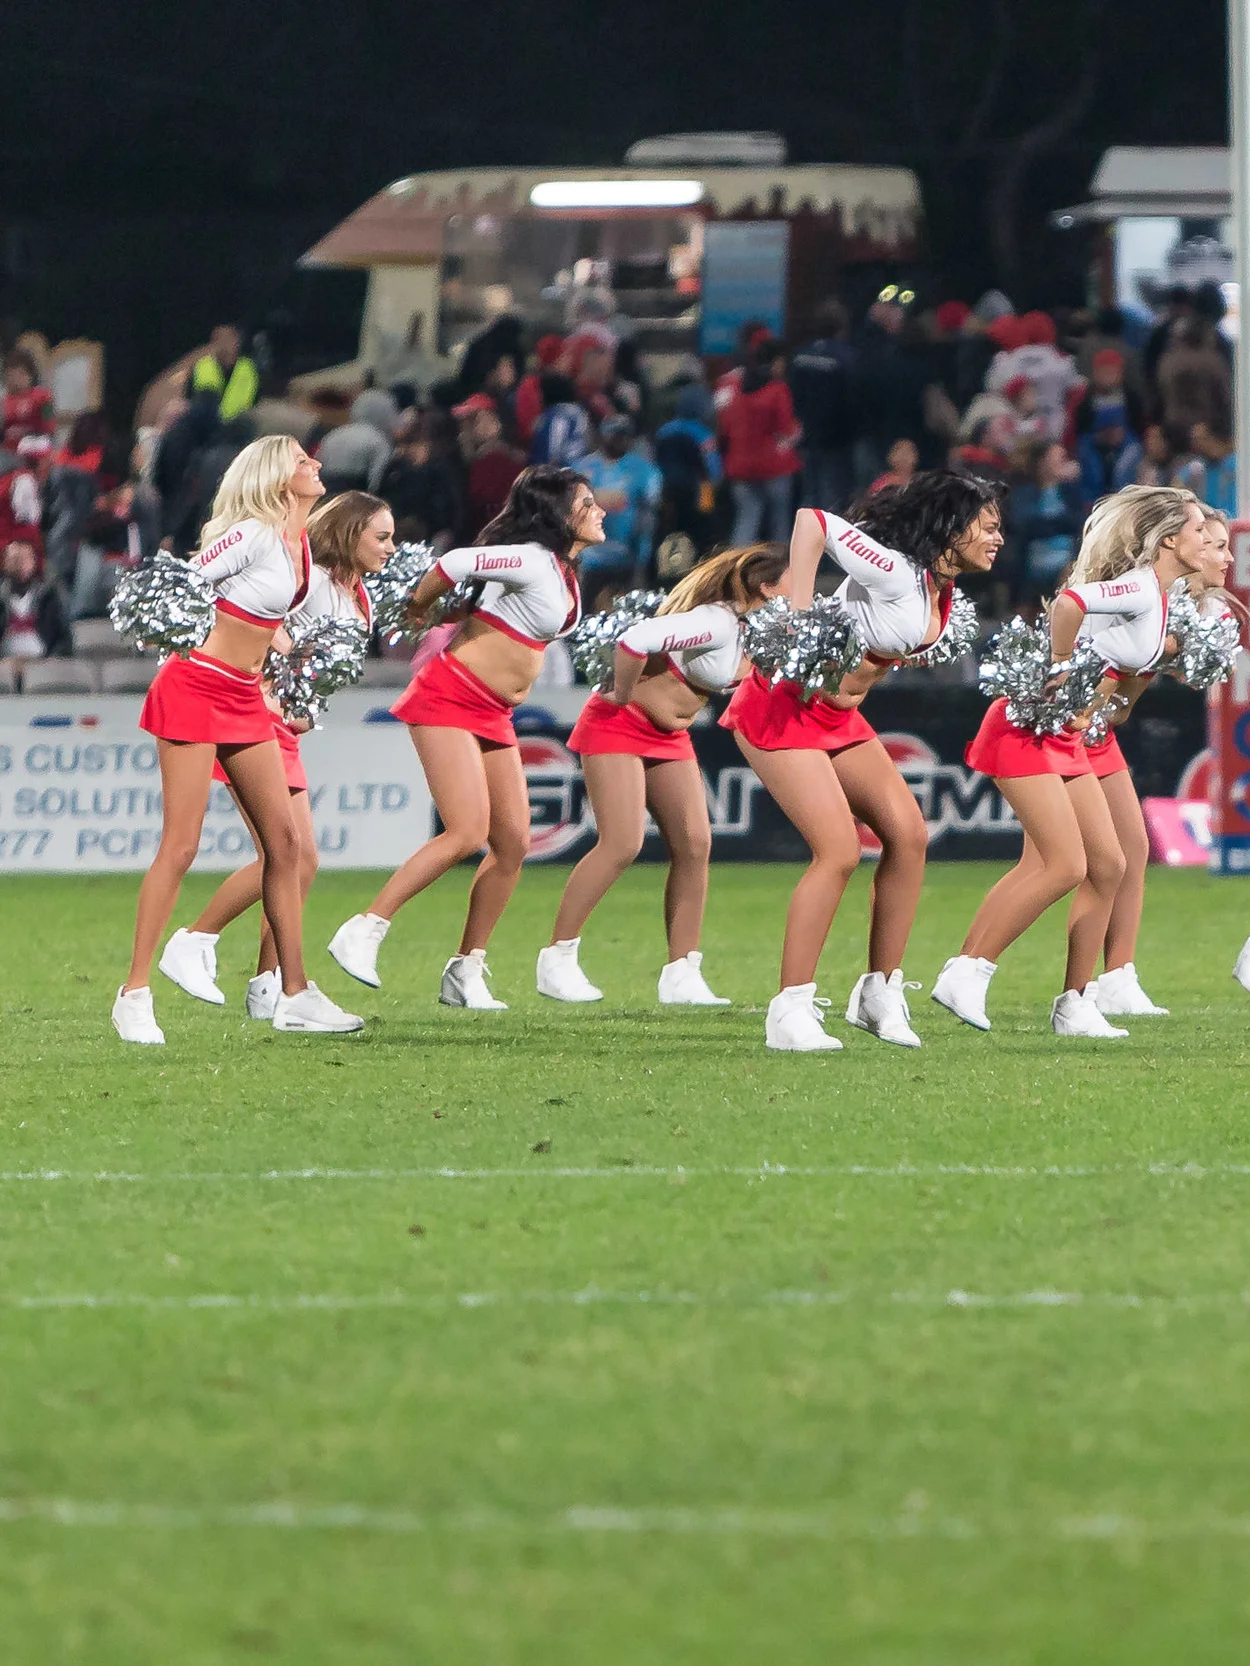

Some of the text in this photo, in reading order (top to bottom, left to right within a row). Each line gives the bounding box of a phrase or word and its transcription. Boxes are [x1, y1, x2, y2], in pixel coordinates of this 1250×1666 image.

[194, 531, 243, 566] lames
[474, 553, 522, 571] Flames
[838, 529, 894, 572] Flames
[661, 631, 712, 651] Flames
[25, 743, 163, 775] CUSTO
[337, 783, 410, 813] LTD
